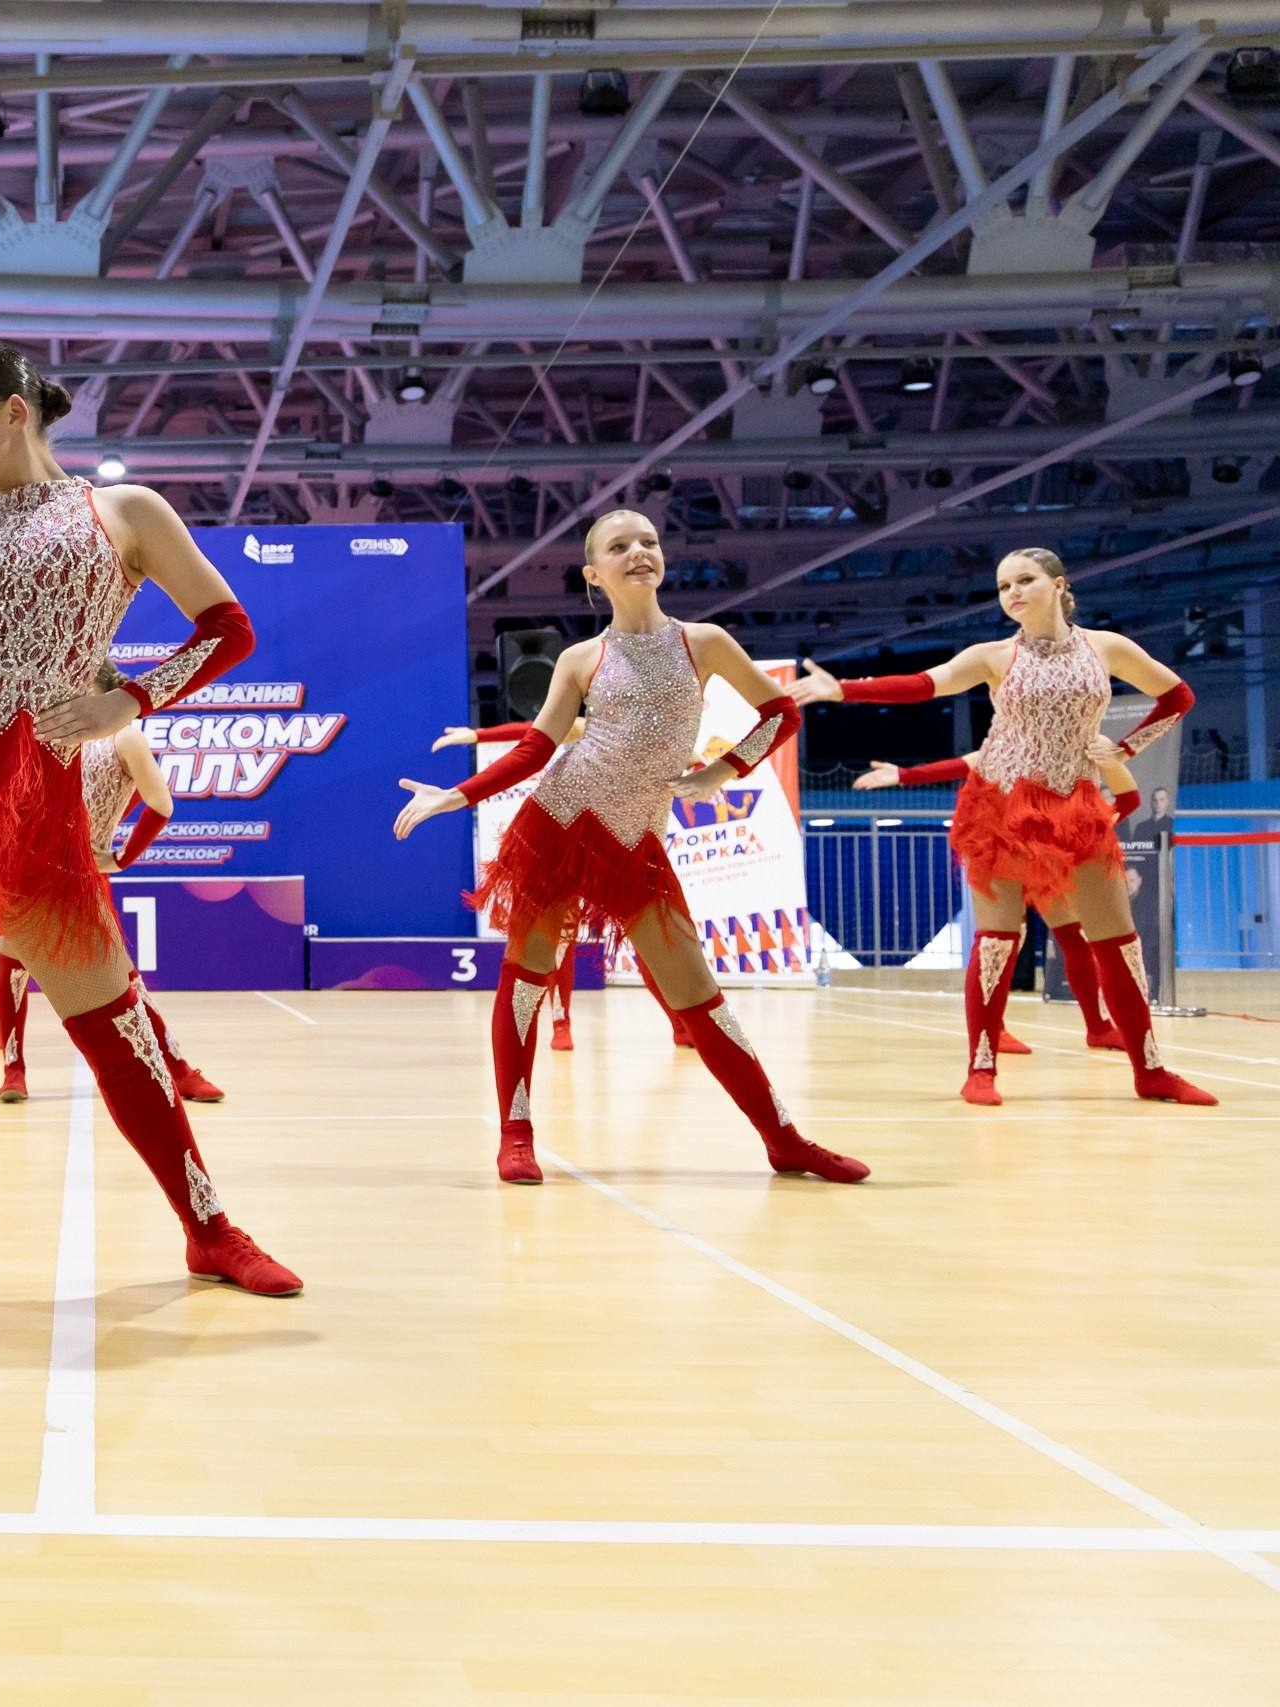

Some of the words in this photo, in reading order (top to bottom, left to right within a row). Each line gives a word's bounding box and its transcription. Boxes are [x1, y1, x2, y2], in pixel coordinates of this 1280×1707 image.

[106, 645, 181, 659] АДИВОС
[131, 715, 339, 750] ЕСКОМУ
[222, 822, 267, 837] КРАЯ
[122, 896, 157, 972] 1
[450, 948, 478, 982] 3
